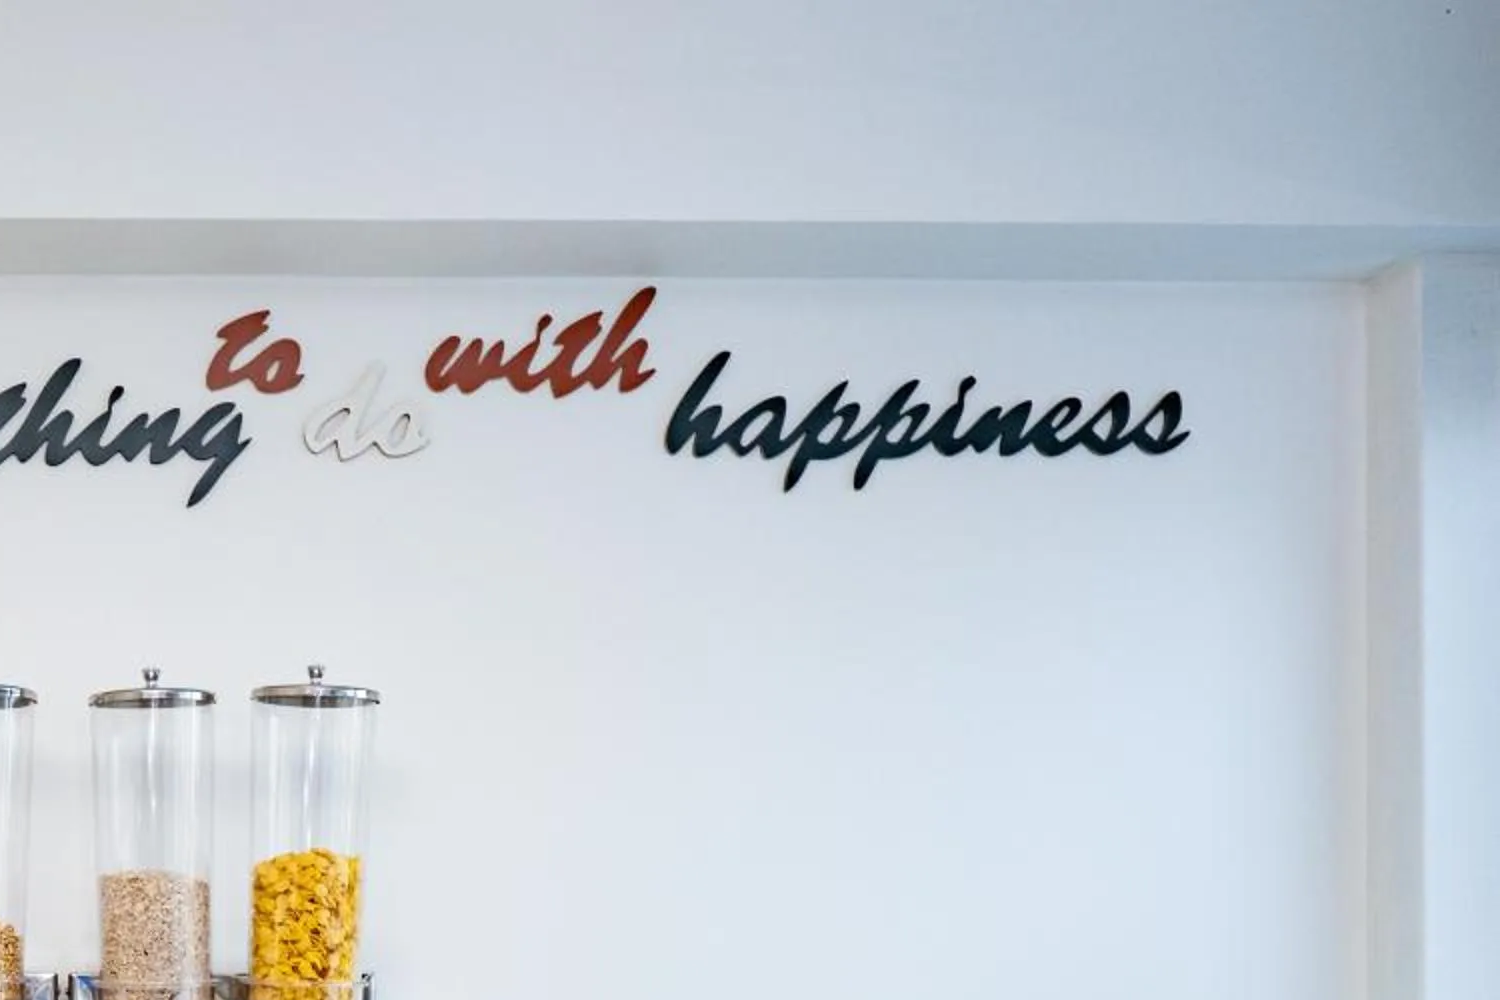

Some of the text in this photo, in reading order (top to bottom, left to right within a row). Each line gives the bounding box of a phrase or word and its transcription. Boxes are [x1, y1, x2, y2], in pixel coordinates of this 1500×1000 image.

[206, 310, 305, 394] to
[301, 358, 431, 463] do
[425, 286, 657, 399] with
[664, 350, 1191, 493] happiness
